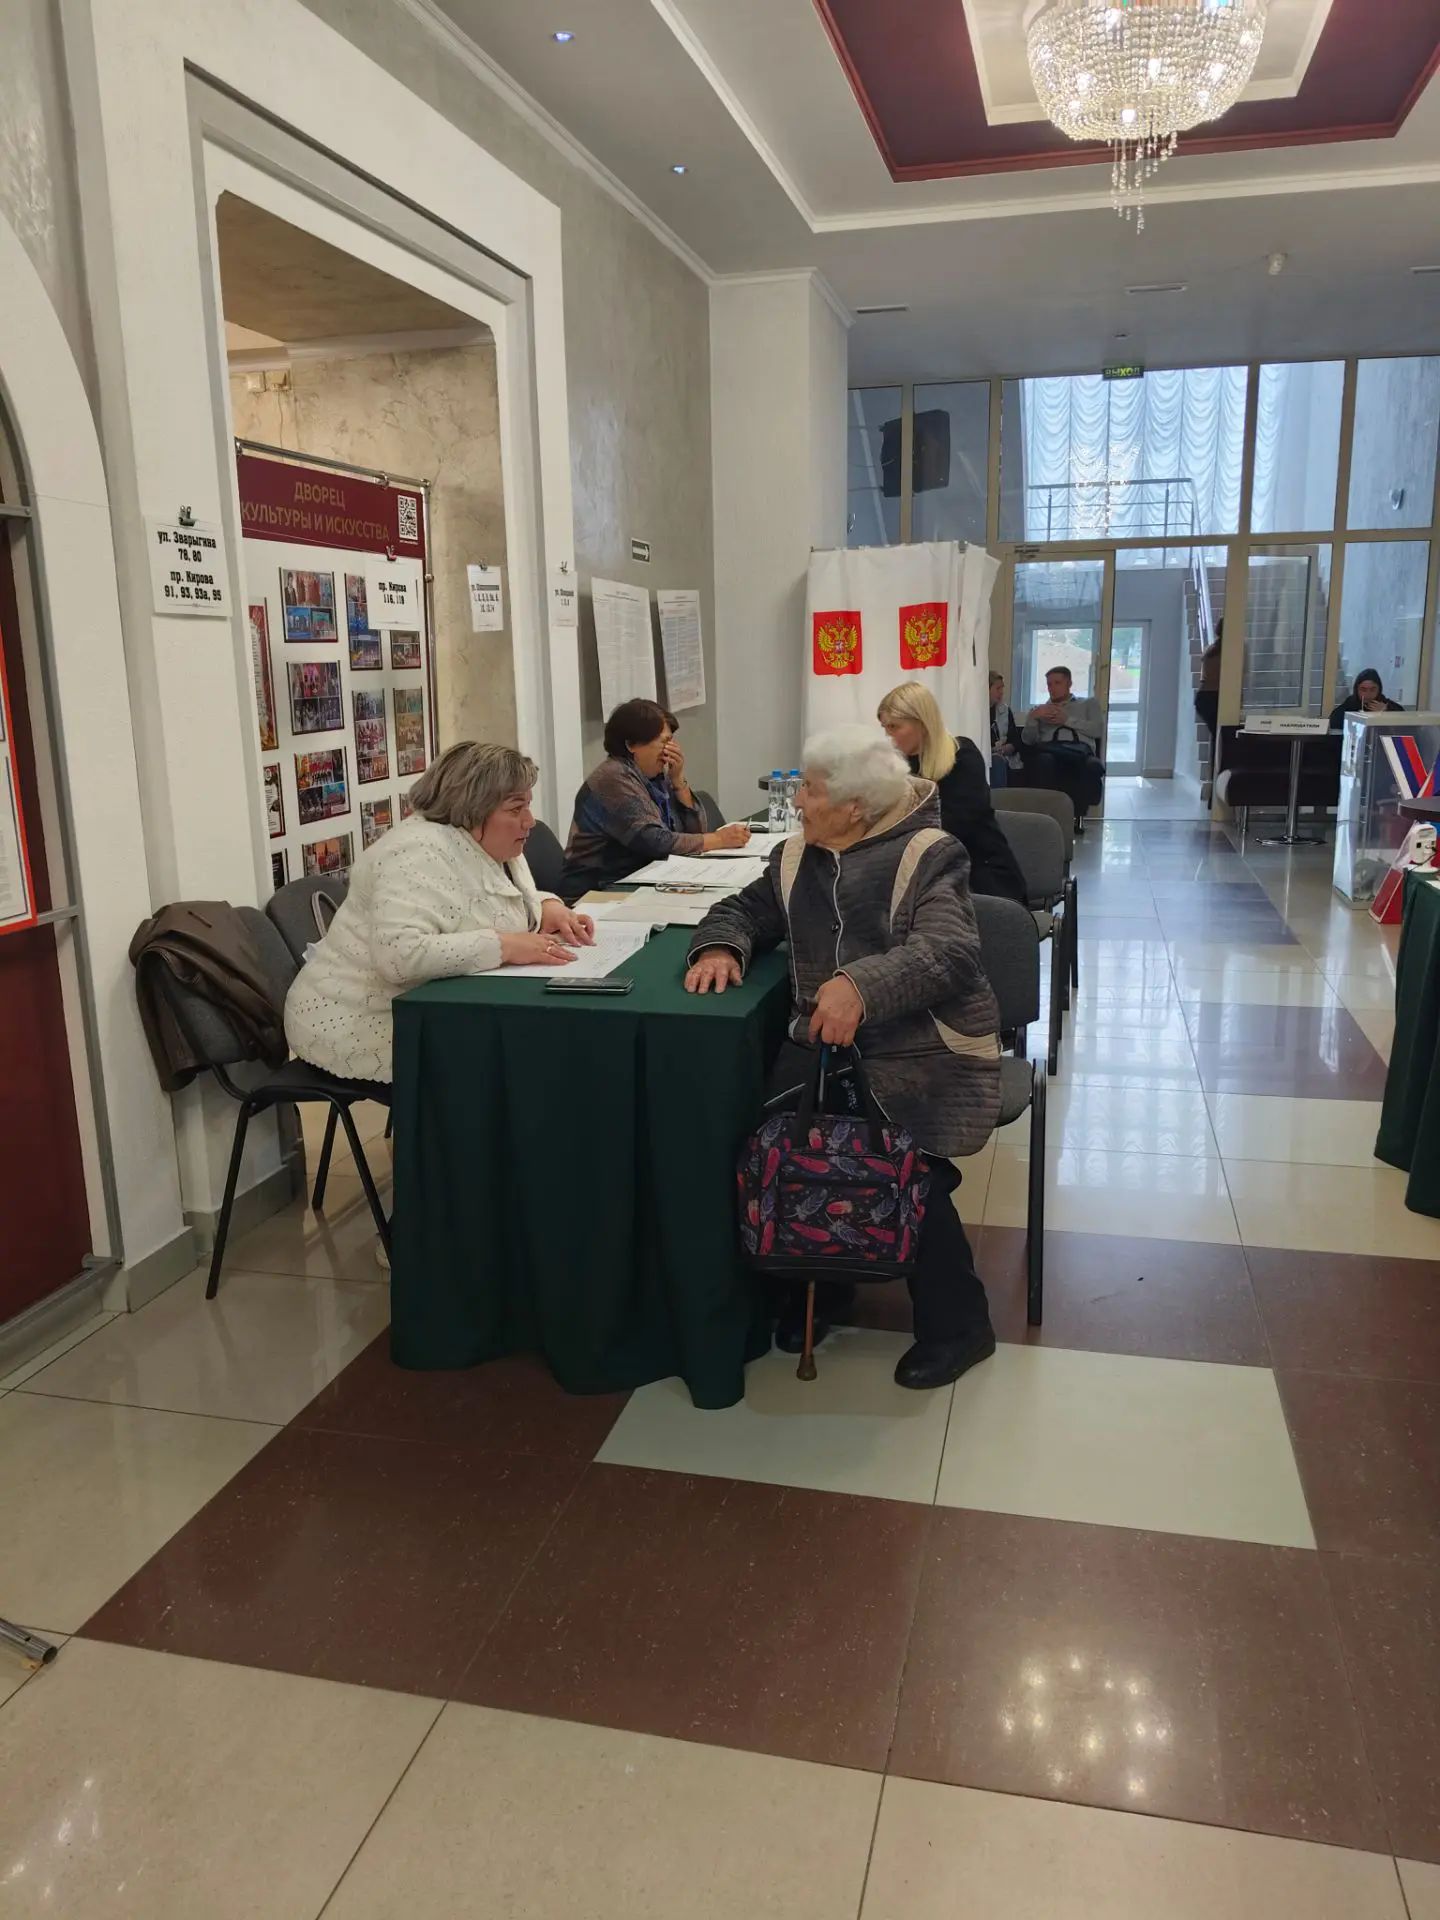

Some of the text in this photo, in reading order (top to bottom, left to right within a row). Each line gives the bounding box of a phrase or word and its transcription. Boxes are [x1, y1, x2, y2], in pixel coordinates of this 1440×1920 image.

[294, 482, 346, 510] ДВОРЕЦ
[241, 501, 390, 541] КУЛЬТУРЫ И ИСКУССТВА
[178, 548, 202, 562] 78, 80
[170, 571, 214, 586] пр. Кирова
[164, 585, 222, 601] 91, 93, 93а, 95
